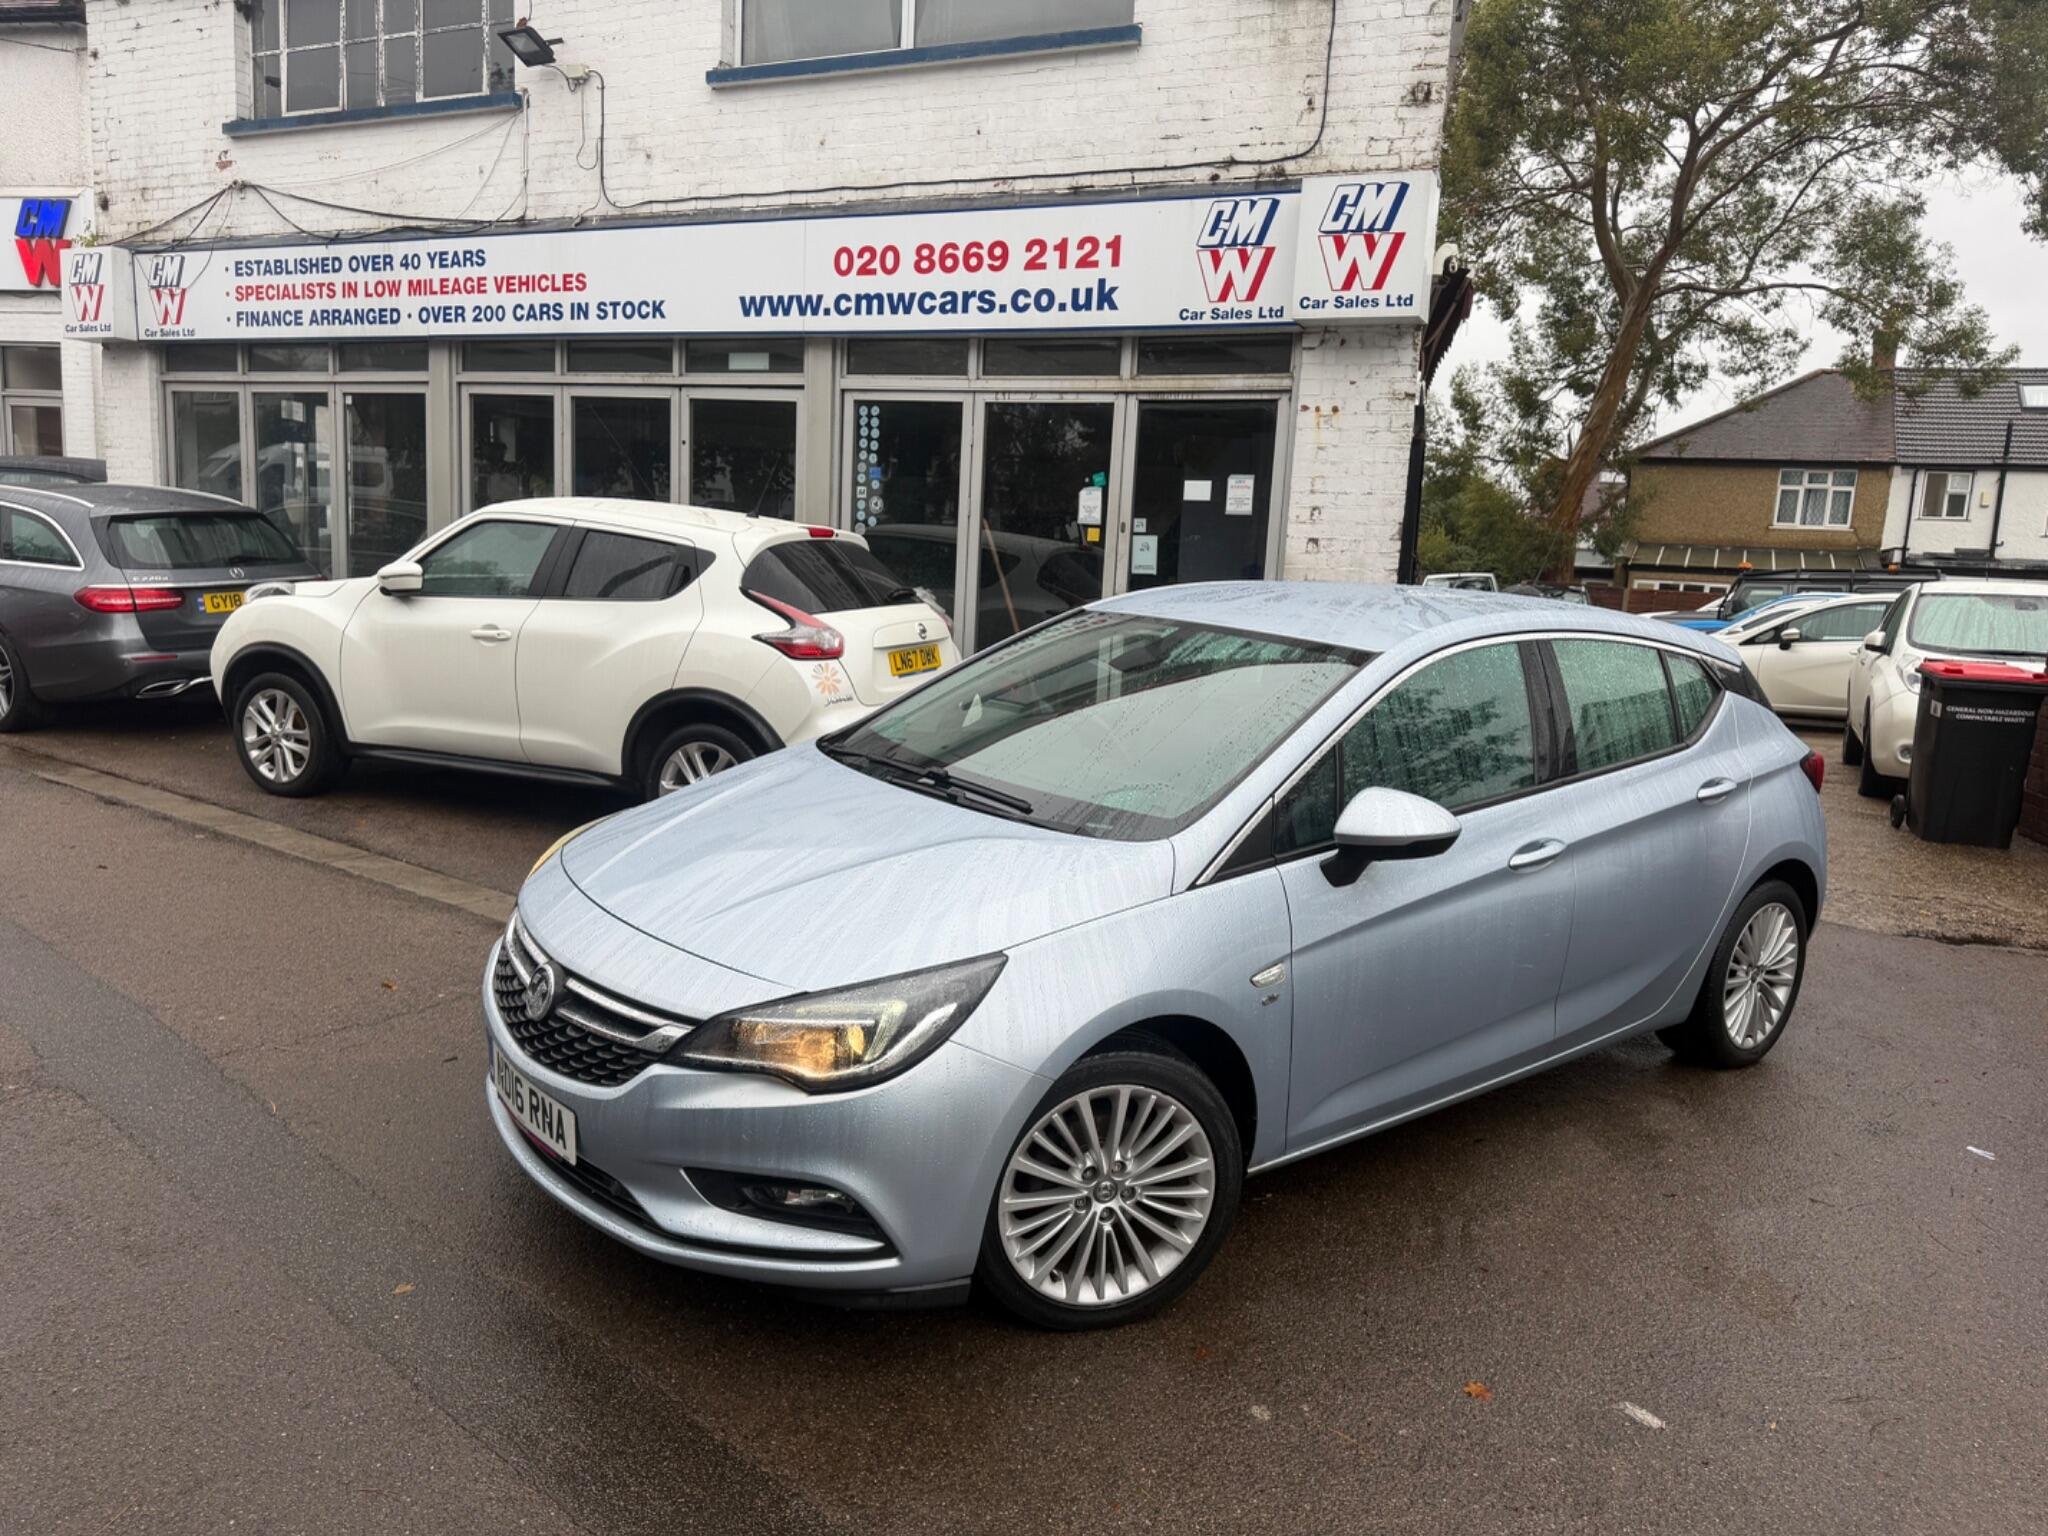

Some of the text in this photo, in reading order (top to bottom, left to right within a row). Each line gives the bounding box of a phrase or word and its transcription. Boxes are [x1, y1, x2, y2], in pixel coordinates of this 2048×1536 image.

[15, 198, 72, 239] CM
[1196, 197, 1280, 248] CM
[1319, 181, 1410, 234] CM
[15, 238, 72, 287] W
[70, 252, 103, 285] CM
[148, 255, 185, 288] CM
[235, 249, 486, 277] ESTABLISHED OVER 40 YEARS
[834, 235, 1121, 277] 020 8669 2121
[1318, 232, 1406, 291] W
[235, 273, 587, 301] SPECIALISTS IN LOW MILEAGE VEHICLES
[1196, 246, 1276, 302] W
[70, 284, 104, 322] W
[148, 287, 188, 325] W
[237, 300, 666, 327] FINANCE ARRANGED OVER 200 CARS IN STOCK
[739, 278, 1119, 317] www.cmwcars.co.uk
[1179, 306, 1284, 321] Car Sales Ltd
[1299, 294, 1413, 310] Car Sales Ltd
[79, 324, 98, 332] Sales
[145, 329, 157, 337] Car
[160, 328, 180, 337] Sales
[210, 593, 243, 610] GY18
